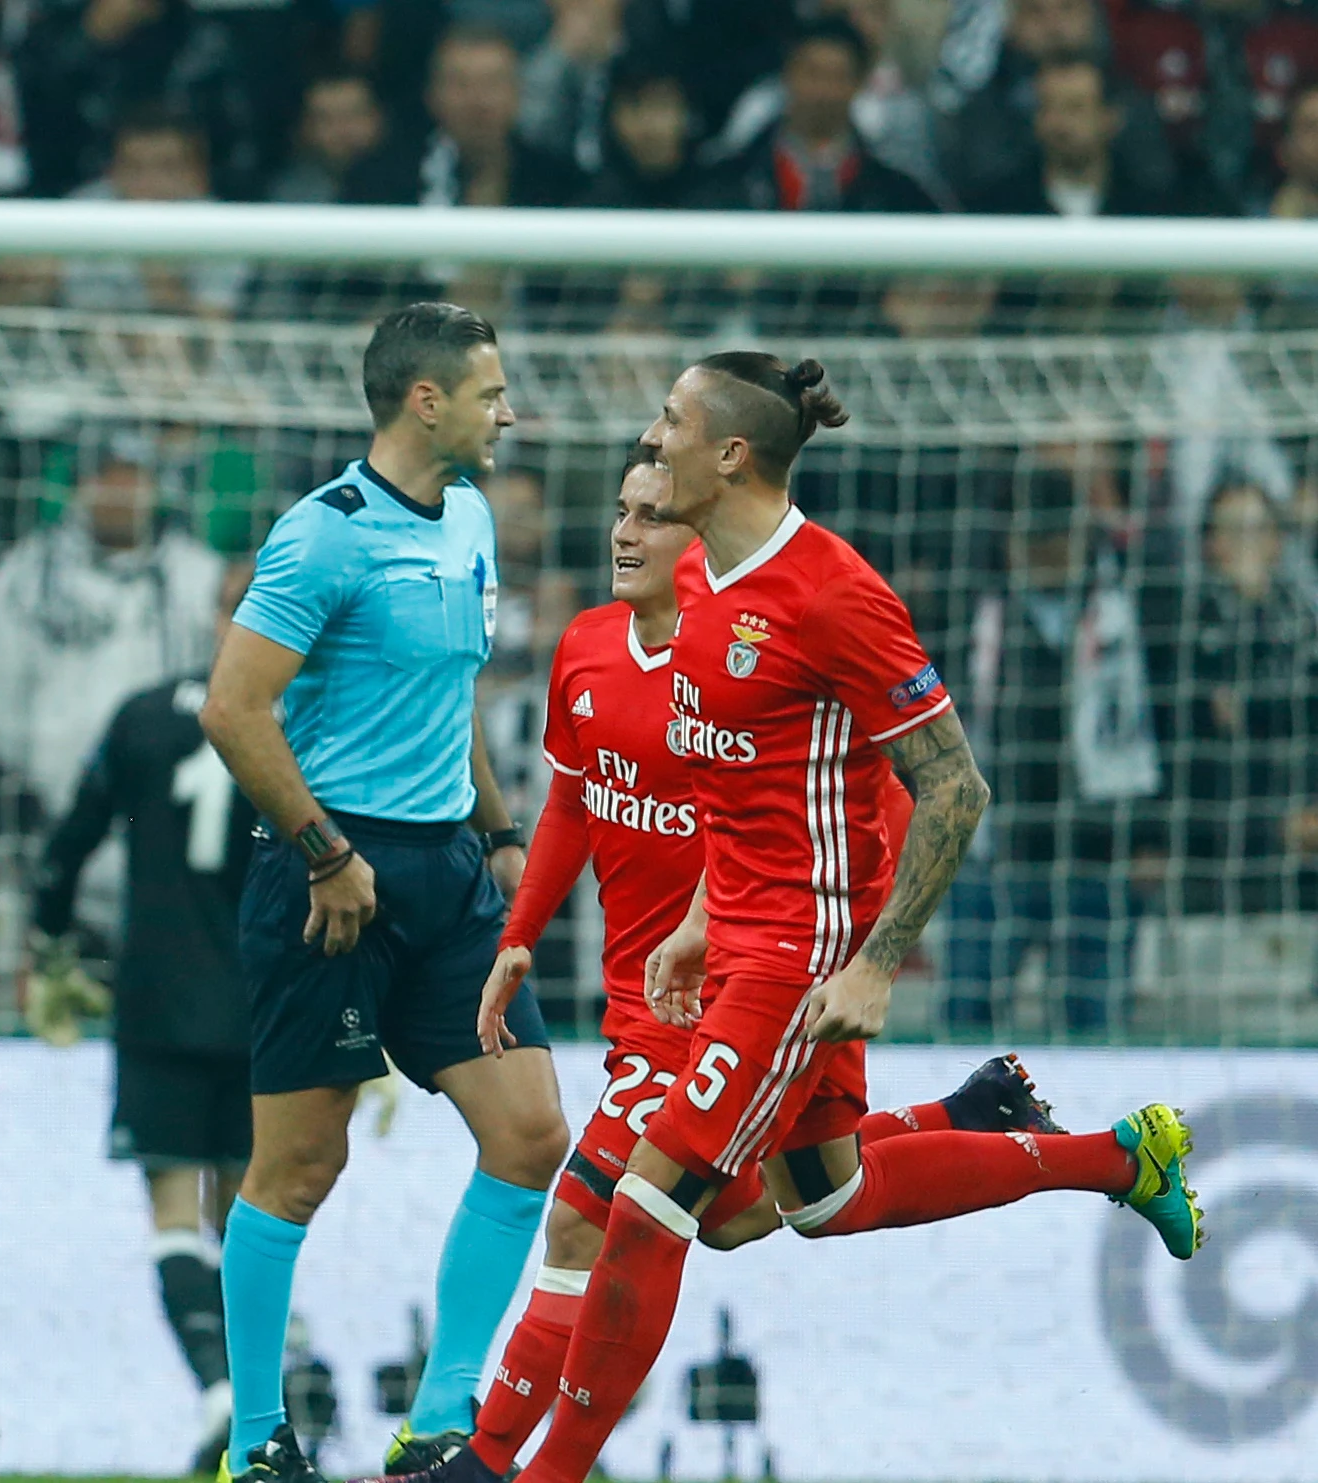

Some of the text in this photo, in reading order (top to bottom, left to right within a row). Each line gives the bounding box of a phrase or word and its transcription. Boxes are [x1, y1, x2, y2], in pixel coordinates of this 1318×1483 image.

[672, 671, 700, 715] Fly
[679, 704, 757, 763] irates
[597, 747, 638, 789] Fly
[171, 740, 233, 873] 1
[581, 777, 697, 837] mirates
[600, 1054, 678, 1136] 22
[686, 1041, 741, 1112] 5
[495, 1365, 533, 1397] SLB
[558, 1376, 591, 1407] SLB
